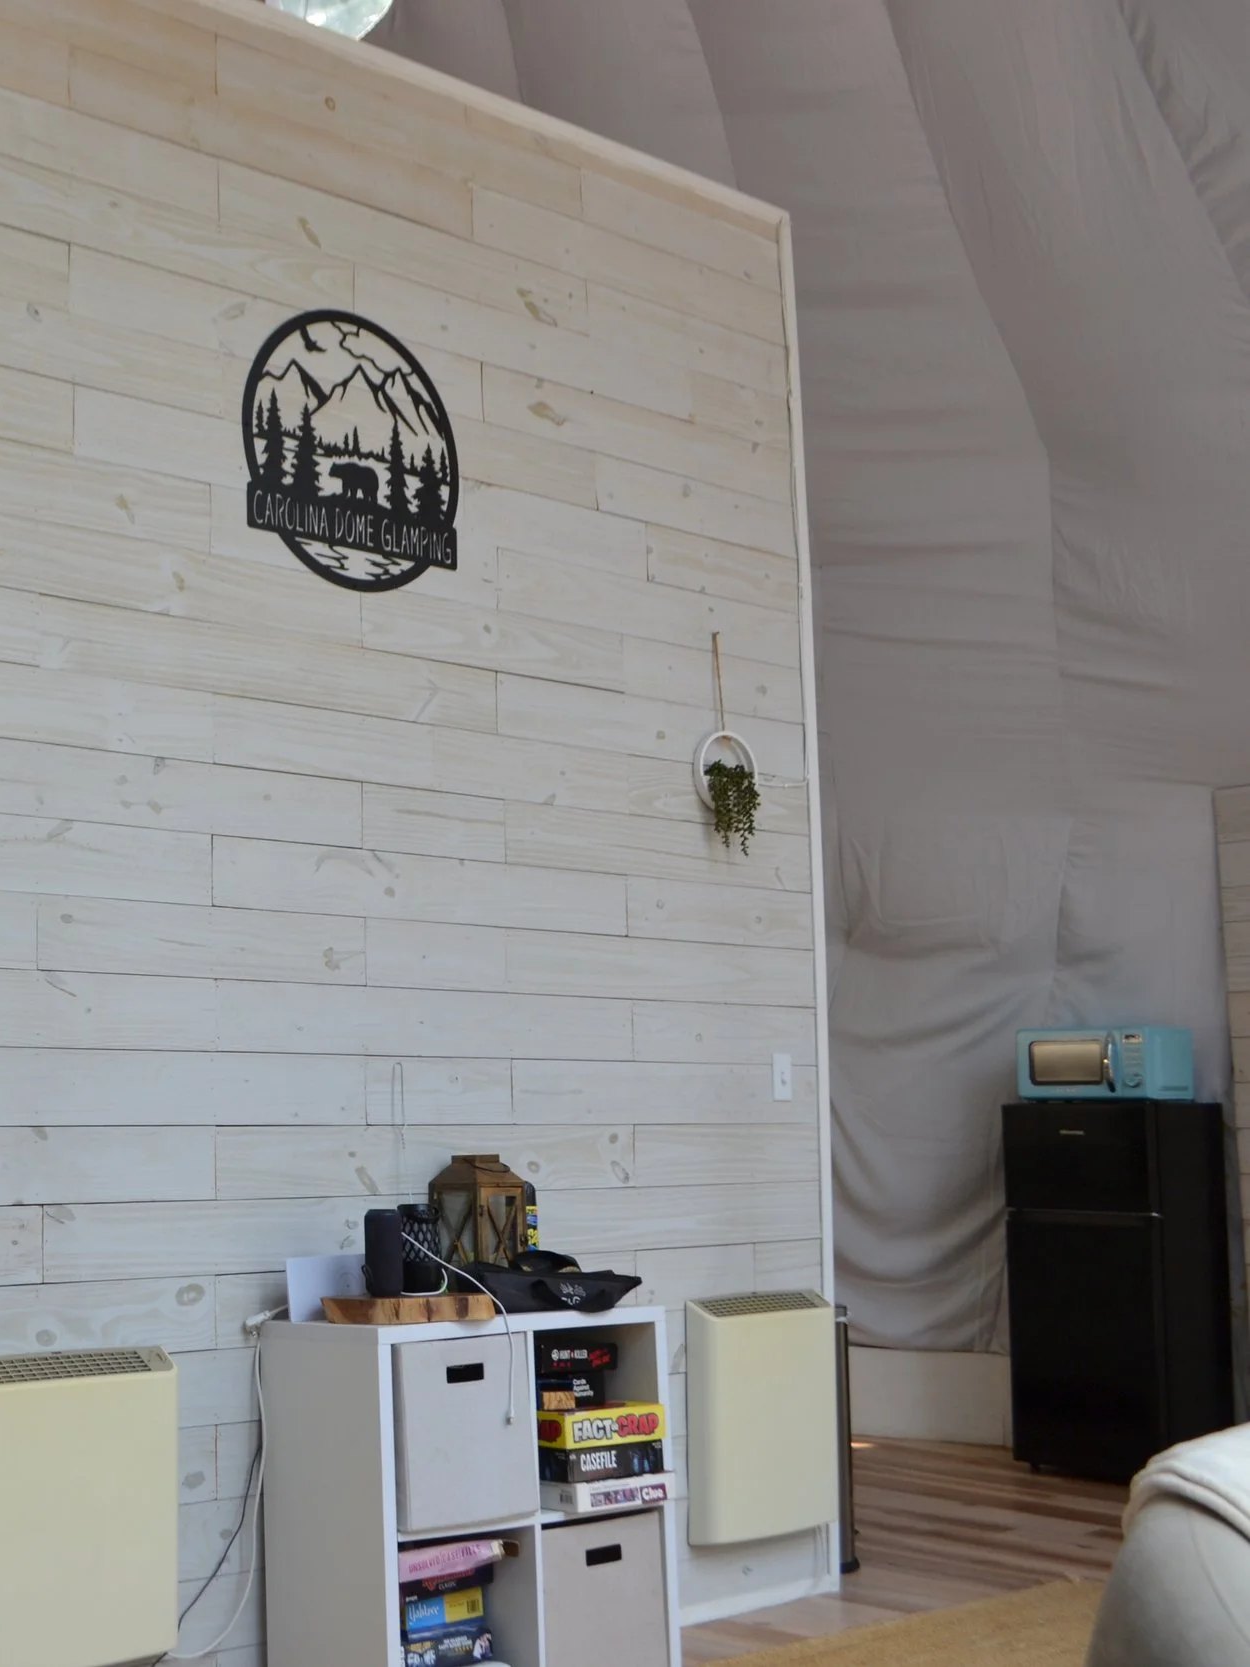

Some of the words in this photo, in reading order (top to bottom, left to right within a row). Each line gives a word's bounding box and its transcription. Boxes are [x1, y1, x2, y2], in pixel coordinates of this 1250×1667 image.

[253, 489, 329, 538] CAROLINA
[335, 507, 374, 548] DOME
[381, 518, 452, 565] GLAMPING
[572, 1418, 613, 1443] FACT
[616, 1412, 659, 1438] CRAP
[580, 1450, 618, 1472] CASEFILE
[641, 1486, 664, 1501] Clue
